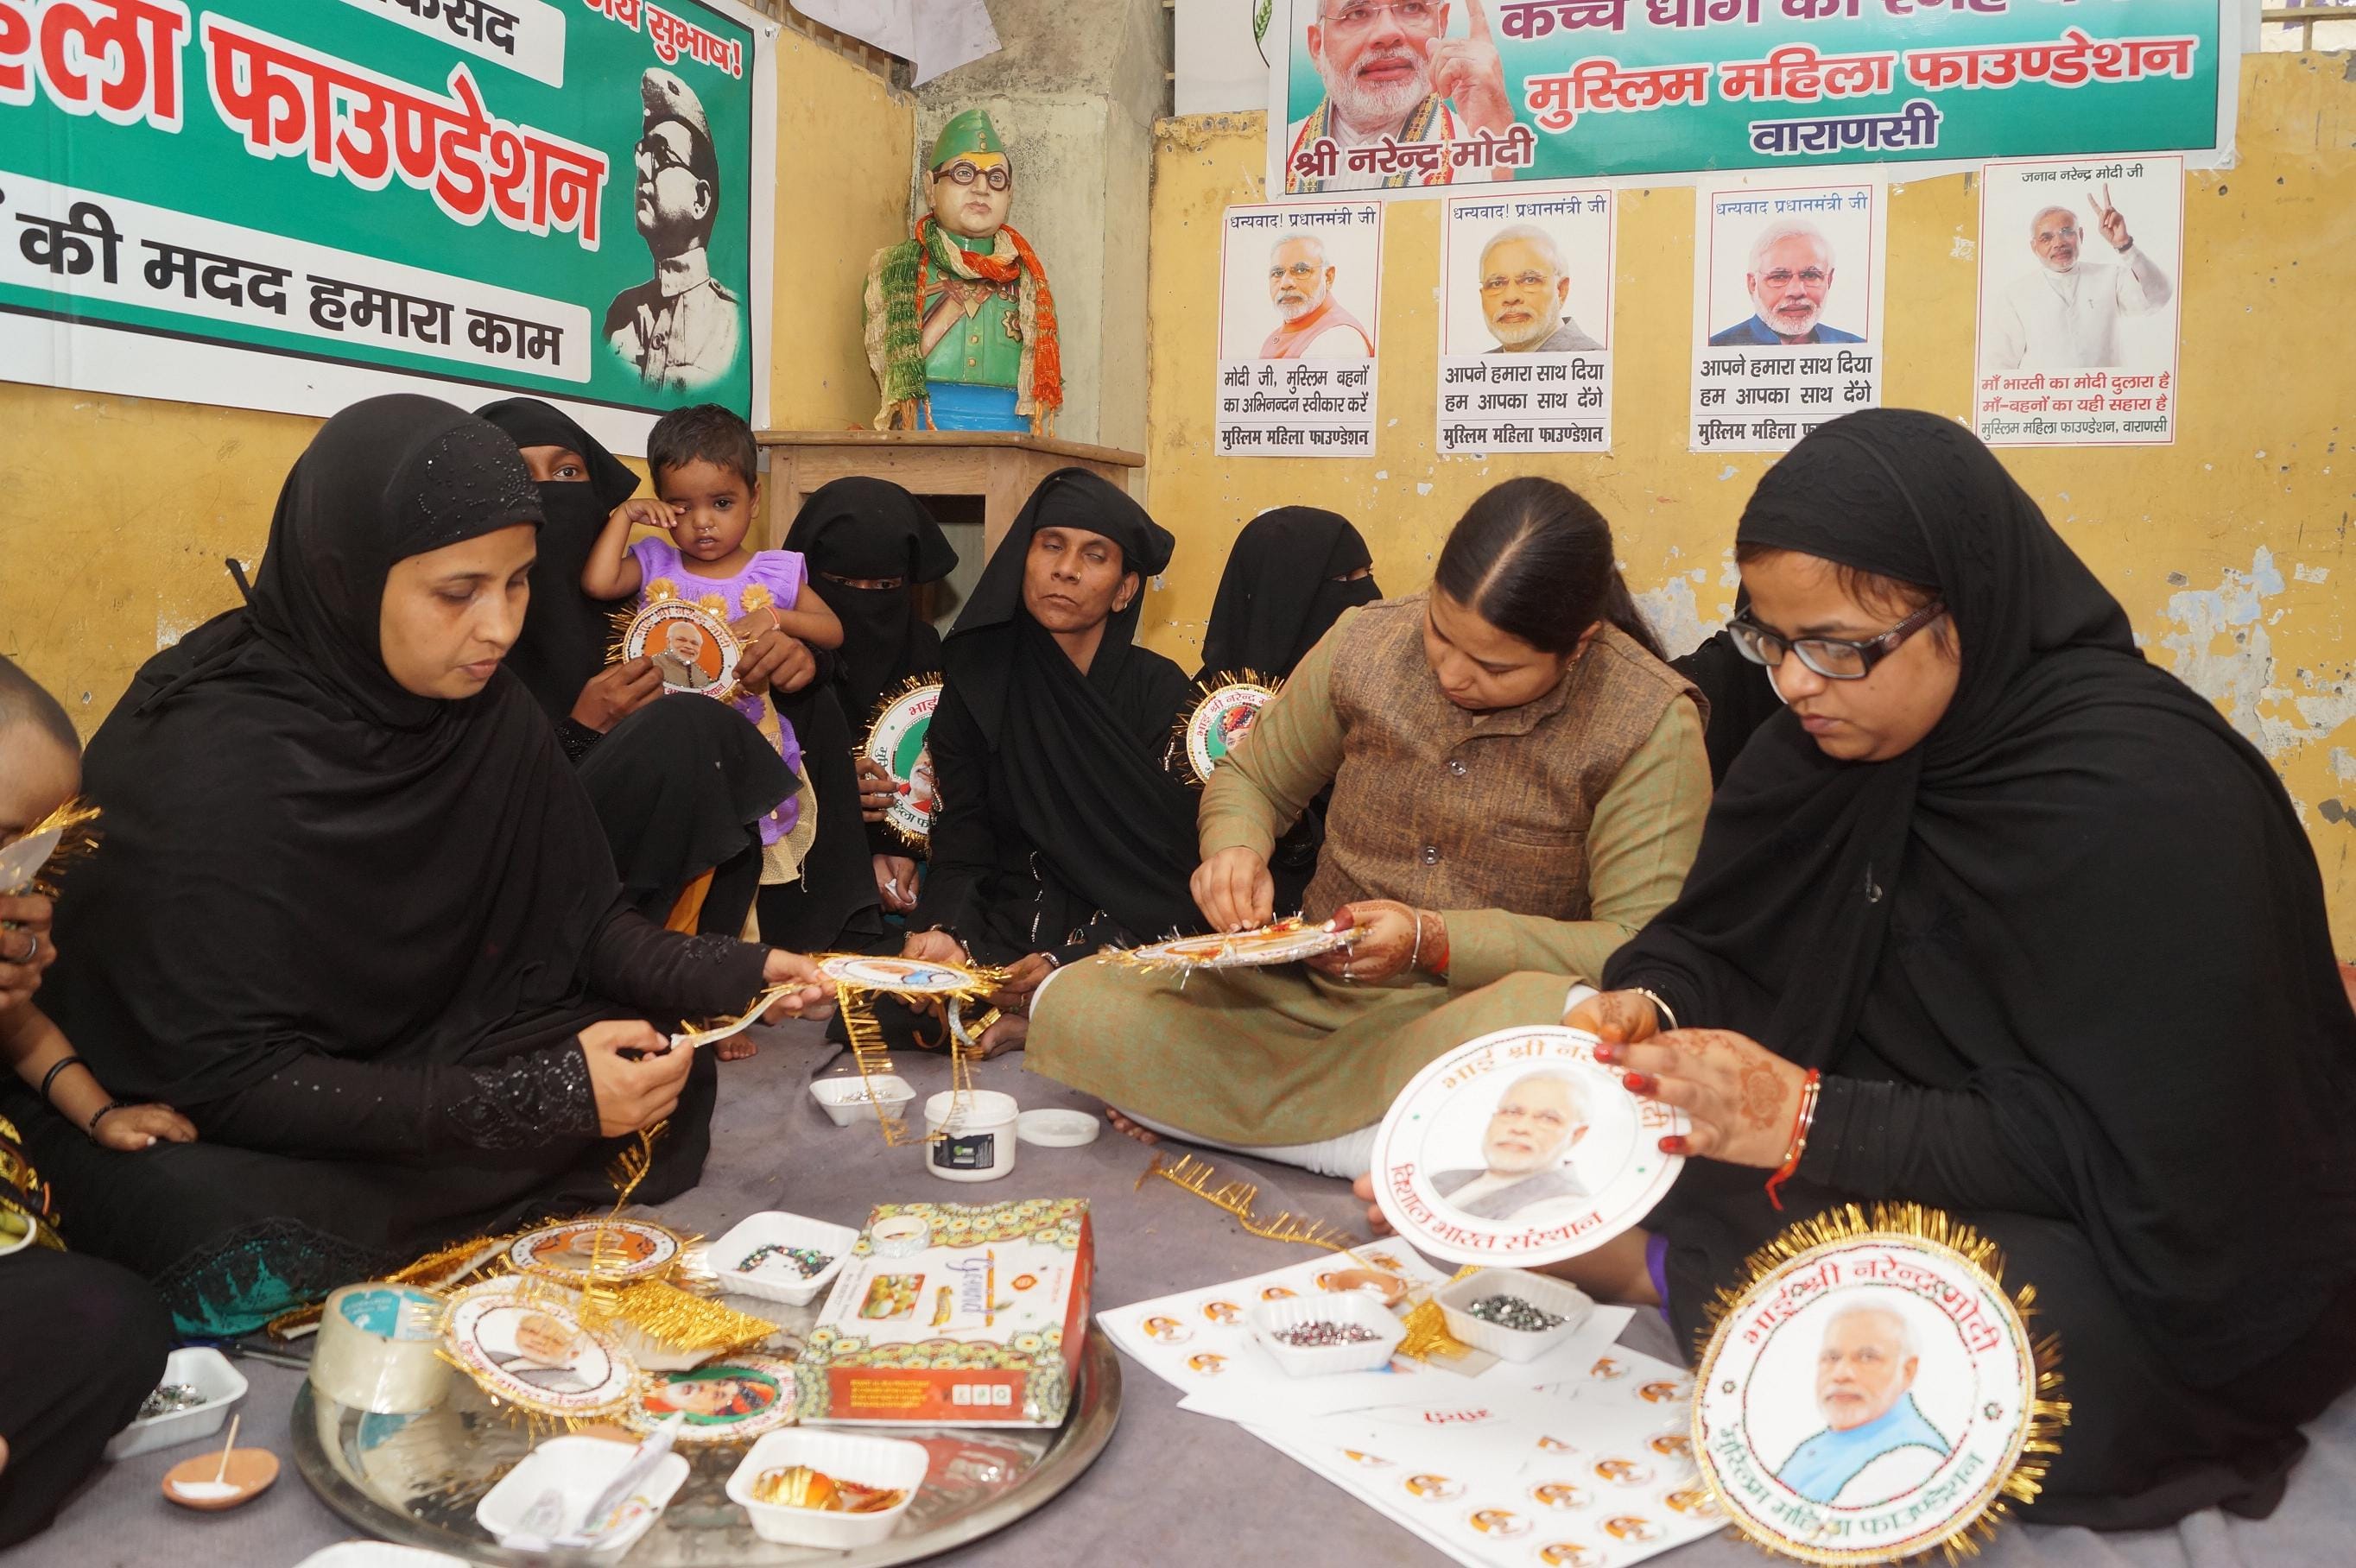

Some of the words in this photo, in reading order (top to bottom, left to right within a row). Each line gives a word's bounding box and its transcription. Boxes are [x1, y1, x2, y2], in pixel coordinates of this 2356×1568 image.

[647, 5, 741, 77] सुभाष!
[1525, 61, 1709, 128] मुस्लिम
[1721, 47, 1896, 99] महिला
[1906, 31, 2194, 88] फाउण्डेशन
[208, 25, 609, 242] फाउण्डेशन
[1751, 101, 1940, 152] वाराणसी
[1294, 136, 1340, 178] श्री
[1347, 130, 1444, 176] नरेन्द्र
[1452, 124, 1536, 168] मोदी
[2060, 166, 2093, 181] नरेन्द्र
[2095, 163, 2123, 179] मोदी
[2126, 162, 2144, 178] जी
[1230, 212, 1283, 229] धन्यवाद!
[1288, 206, 1352, 227] प्रधानमंत्री
[1357, 205, 1377, 225] जी
[1453, 203, 1509, 221] धन्यवाद!
[1515, 195, 1582, 218] प्रधानमंत्री
[1586, 194, 1607, 213] जी
[1715, 200, 1770, 216] धन्यवाद
[1774, 192, 1843, 213] प्रधानमंत्री
[1848, 191, 1869, 211] जी
[15, 200, 124, 285] की
[140, 237, 292, 316] मदद
[306, 274, 454, 345] हमारा
[466, 307, 564, 366] काम
[1444, 361, 1487, 383] आपने
[1491, 365, 1533, 384] हमारा
[1536, 364, 1568, 382] साथ
[1571, 357, 1605, 381] दिया
[1700, 353, 1746, 377] आपने
[1750, 358, 1796, 377] हमारा
[1799, 357, 1834, 376] साथ
[1837, 350, 1873, 375] दिया
[1224, 364, 1251, 387] मोदी
[1257, 364, 1277, 388] जी,
[1286, 364, 1328, 395] मुस्लिम
[1336, 364, 1371, 388] बहनों
[1981, 374, 2002, 391] माँ
[2003, 373, 2045, 390] भारती
[2049, 377, 2070, 389] का
[2074, 372, 2109, 389] मोदी
[2111, 376, 2155, 395] दुलारा
[2157, 371, 2171, 389] है
[1223, 397, 1240, 413] का
[1241, 391, 1300, 414] अभिनन्दन
[1302, 390, 1346, 413] स्वीकार
[1347, 391, 1370, 413] करें
[1444, 394, 1469, 412] हम
[1477, 393, 1528, 410] आपका
[1536, 392, 1568, 409] साथ
[1577, 386, 1604, 408] देंगे
[1700, 388, 1726, 407] हम
[1735, 387, 1791, 405] आपका
[1800, 386, 1834, 404] साथ
[1843, 380, 1872, 403] देंगे
[2052, 399, 2073, 412] का
[2076, 394, 2106, 412] यही
[2108, 398, 2152, 411] सहारा
[2156, 393, 2169, 412] है
[1221, 426, 1263, 451] मुस्लिम
[1266, 426, 1306, 446] महिला
[1308, 426, 1370, 446] फाउण्डेशन
[1443, 424, 1488, 450] मुस्लिम
[1492, 423, 1535, 444] महिला
[1538, 422, 1604, 443] फाउण्डेशन
[1697, 419, 1747, 446] मुस्लिम
[1751, 418, 1797, 439] महिला
[1981, 418, 2020, 441] मुस्लिम
[2023, 417, 2058, 434] महिला
[2060, 417, 2118, 433] फाउण्डेशन,
[2123, 415, 2168, 433] वाराणसी
[1431, 1220, 1496, 1249] भारत
